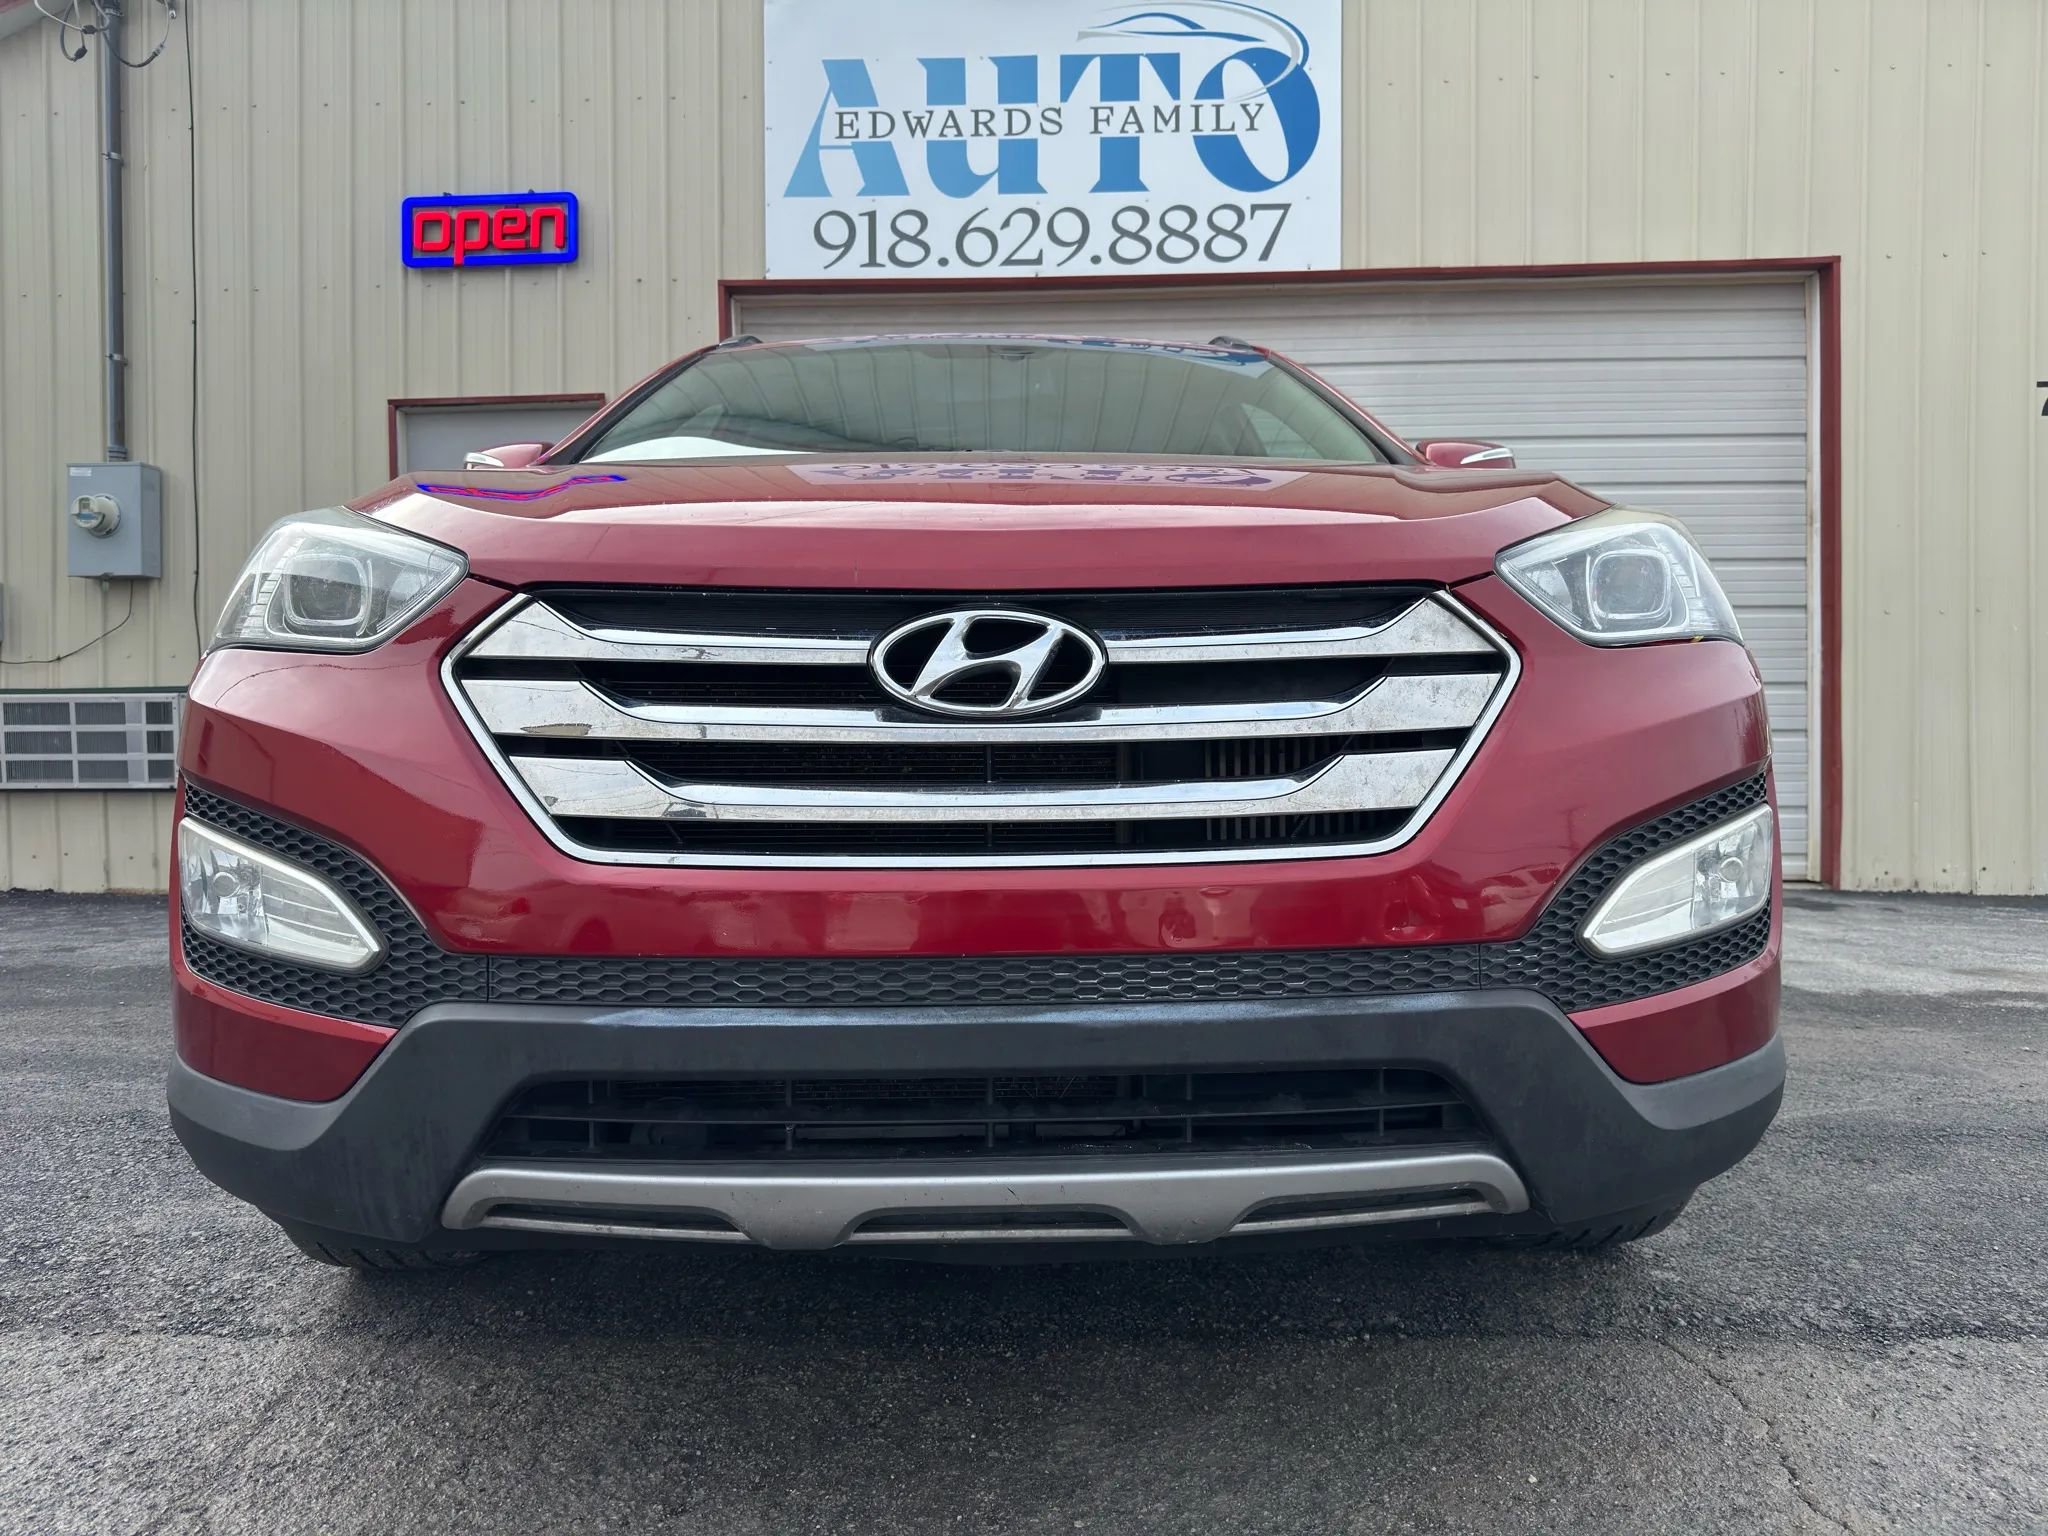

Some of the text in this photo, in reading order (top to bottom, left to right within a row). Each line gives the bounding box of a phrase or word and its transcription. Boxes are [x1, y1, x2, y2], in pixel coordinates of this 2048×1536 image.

[783, 47, 1321, 199] AUTO
[835, 103, 1266, 141] EDWARDS FAMILY
[413, 206, 566, 267] open
[813, 203, 1293, 271] 918.629.8887
